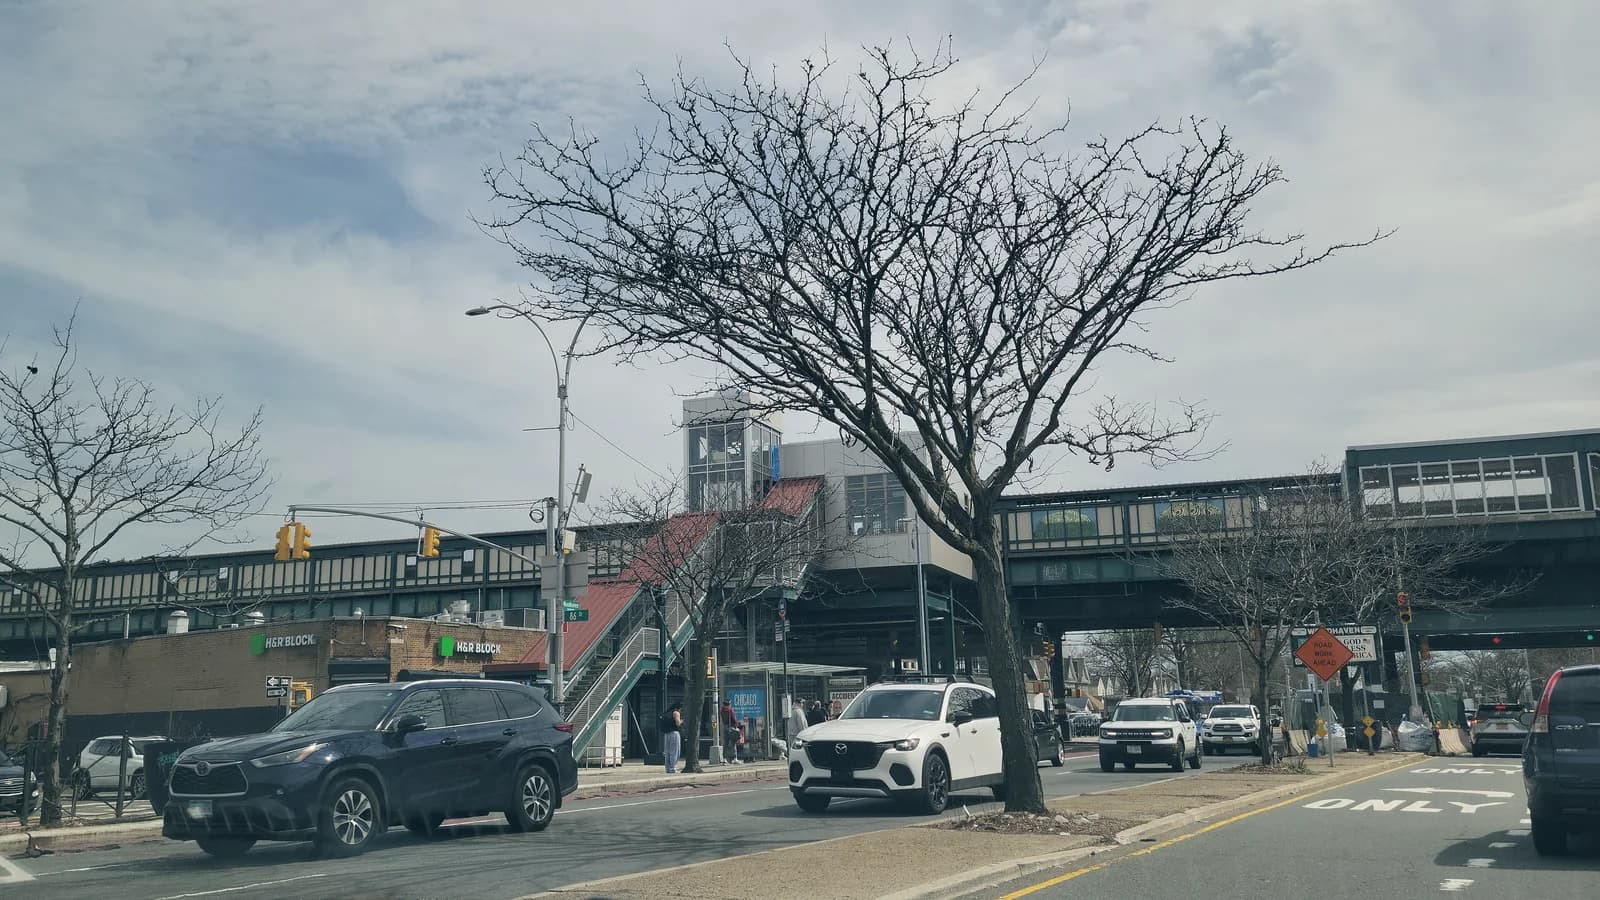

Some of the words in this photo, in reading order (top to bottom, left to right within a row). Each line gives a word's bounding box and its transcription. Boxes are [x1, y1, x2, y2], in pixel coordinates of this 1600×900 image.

[265, 636, 283, 649] H&R
[285, 633, 316, 647] BLOCK
[456, 641, 474, 653] H&R
[475, 642, 501, 654] BLOCK
[1313, 641, 1333, 649] ROAD
[733, 693, 757, 706] CHICAGO
[1301, 798, 1509, 814] ONLY
